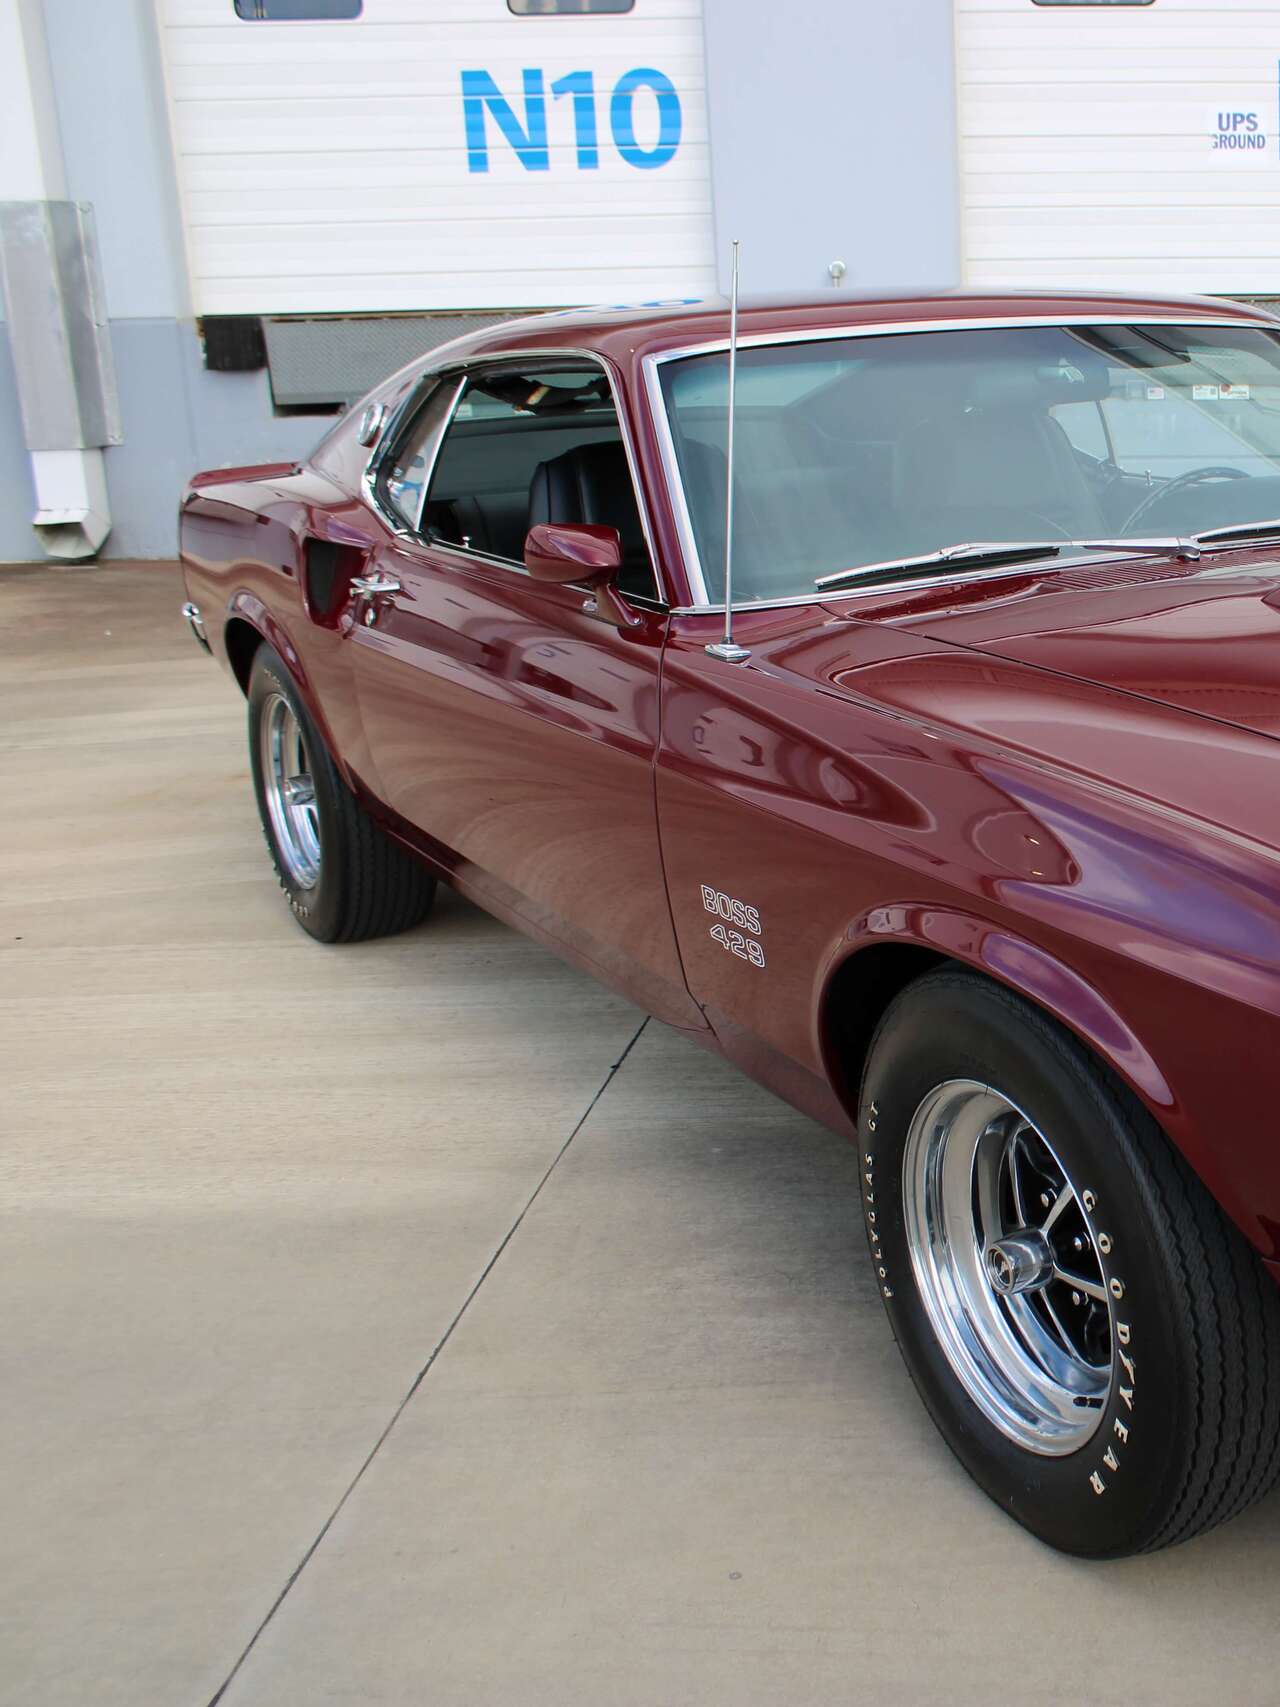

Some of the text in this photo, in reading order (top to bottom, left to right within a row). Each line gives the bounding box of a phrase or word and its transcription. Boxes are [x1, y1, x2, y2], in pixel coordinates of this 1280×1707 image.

[460, 67, 682, 173] N10
[1211, 133, 1266, 150] GROUND
[1217, 112, 1259, 132] UPS
[700, 884, 762, 935] BOSS
[709, 923, 766, 968] 429
[1081, 1189, 1137, 1495] GOODYEAR
